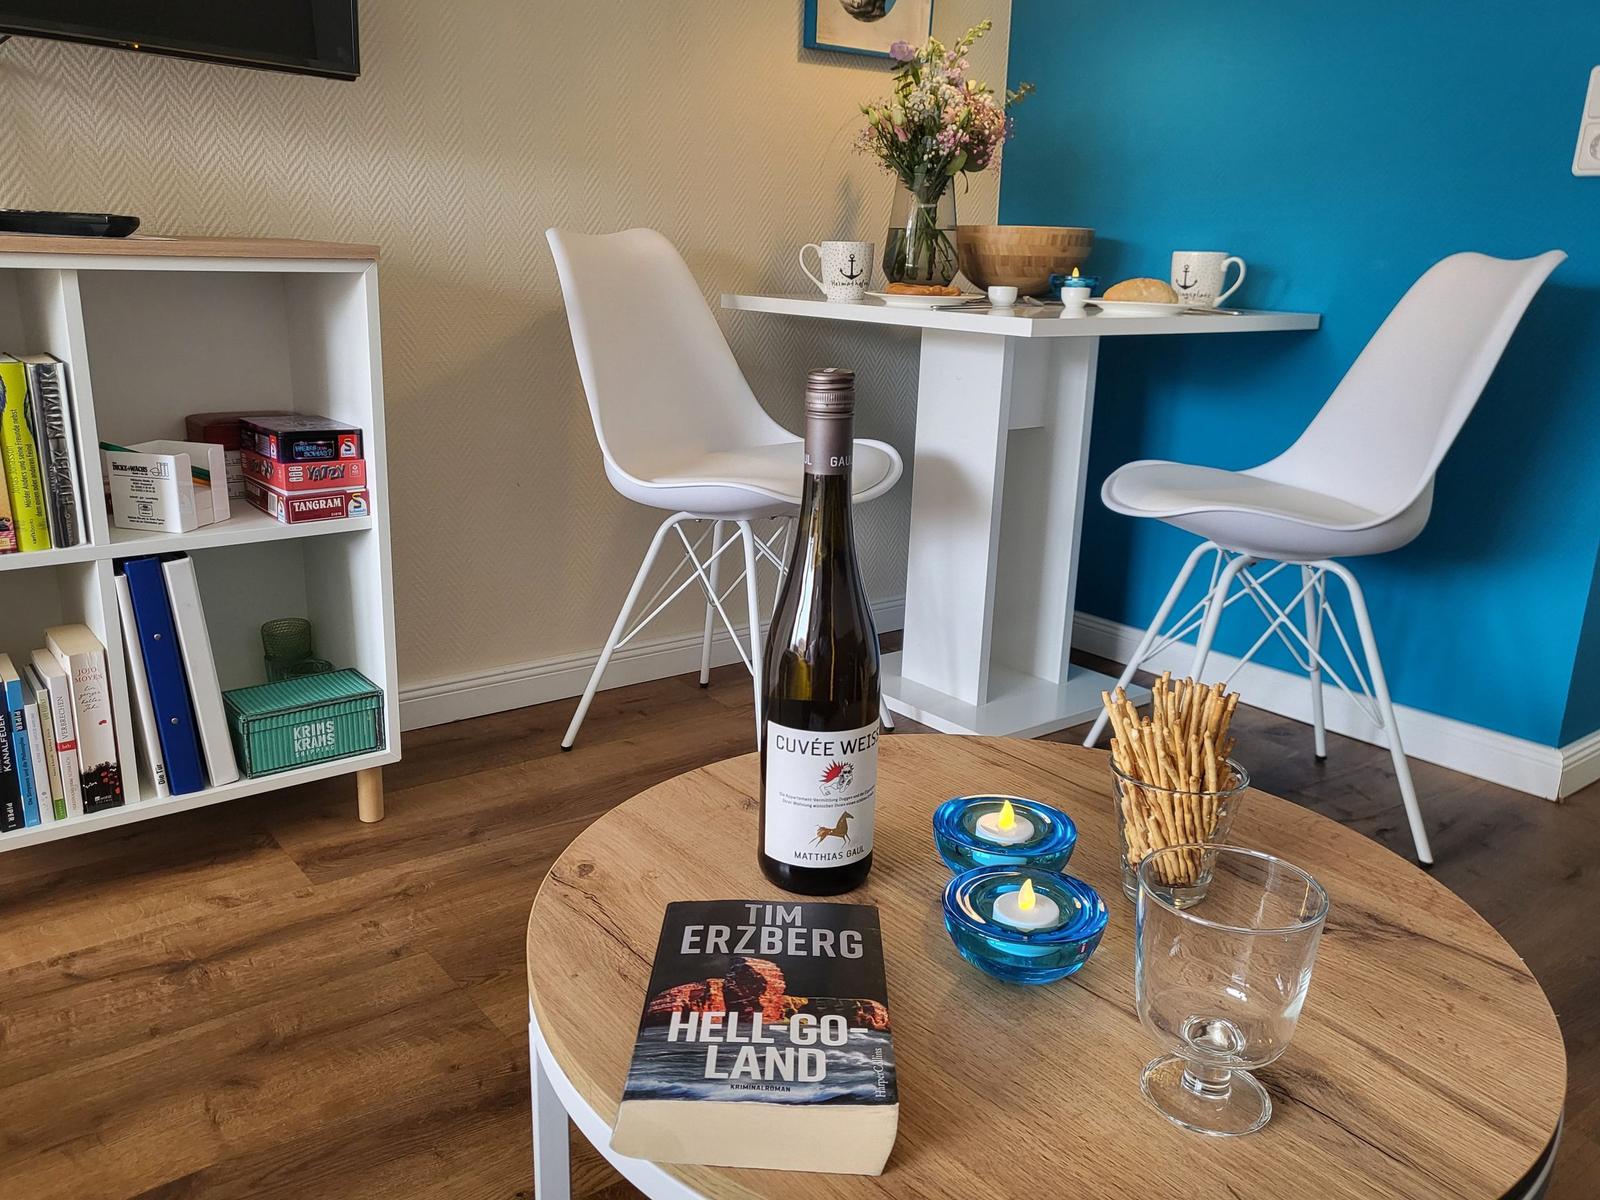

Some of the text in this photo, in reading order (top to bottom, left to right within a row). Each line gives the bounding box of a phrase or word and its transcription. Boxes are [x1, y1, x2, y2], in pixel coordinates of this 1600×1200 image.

[40, 371, 65, 440] MIMIK
[13, 424, 22, 446] Freunde
[830, 456, 853, 467] GAU
[20, 471, 29, 490] Anders
[306, 464, 346, 481] YATZY
[293, 498, 342, 512] TANGRAM
[78, 667, 97, 677] JOJO
[14, 710, 23, 732] PIPER
[57, 696, 69, 740] VERBRECHEN
[293, 721, 334, 739] KRIMS
[294, 733, 335, 752] KRAMS
[776, 735, 835, 756] CUVÉE
[158, 774, 166, 785] Die
[6, 802, 16, 822] PIPER
[794, 846, 865, 861] MATTHIAS GAUL
[745, 904, 802, 927] TIM
[680, 925, 864, 959] ERZBERG
[704, 1045, 827, 1083] LAND
[872, 1047, 887, 1098] HarperCollins
[730, 1084, 791, 1093] KRIMINALROMAN
